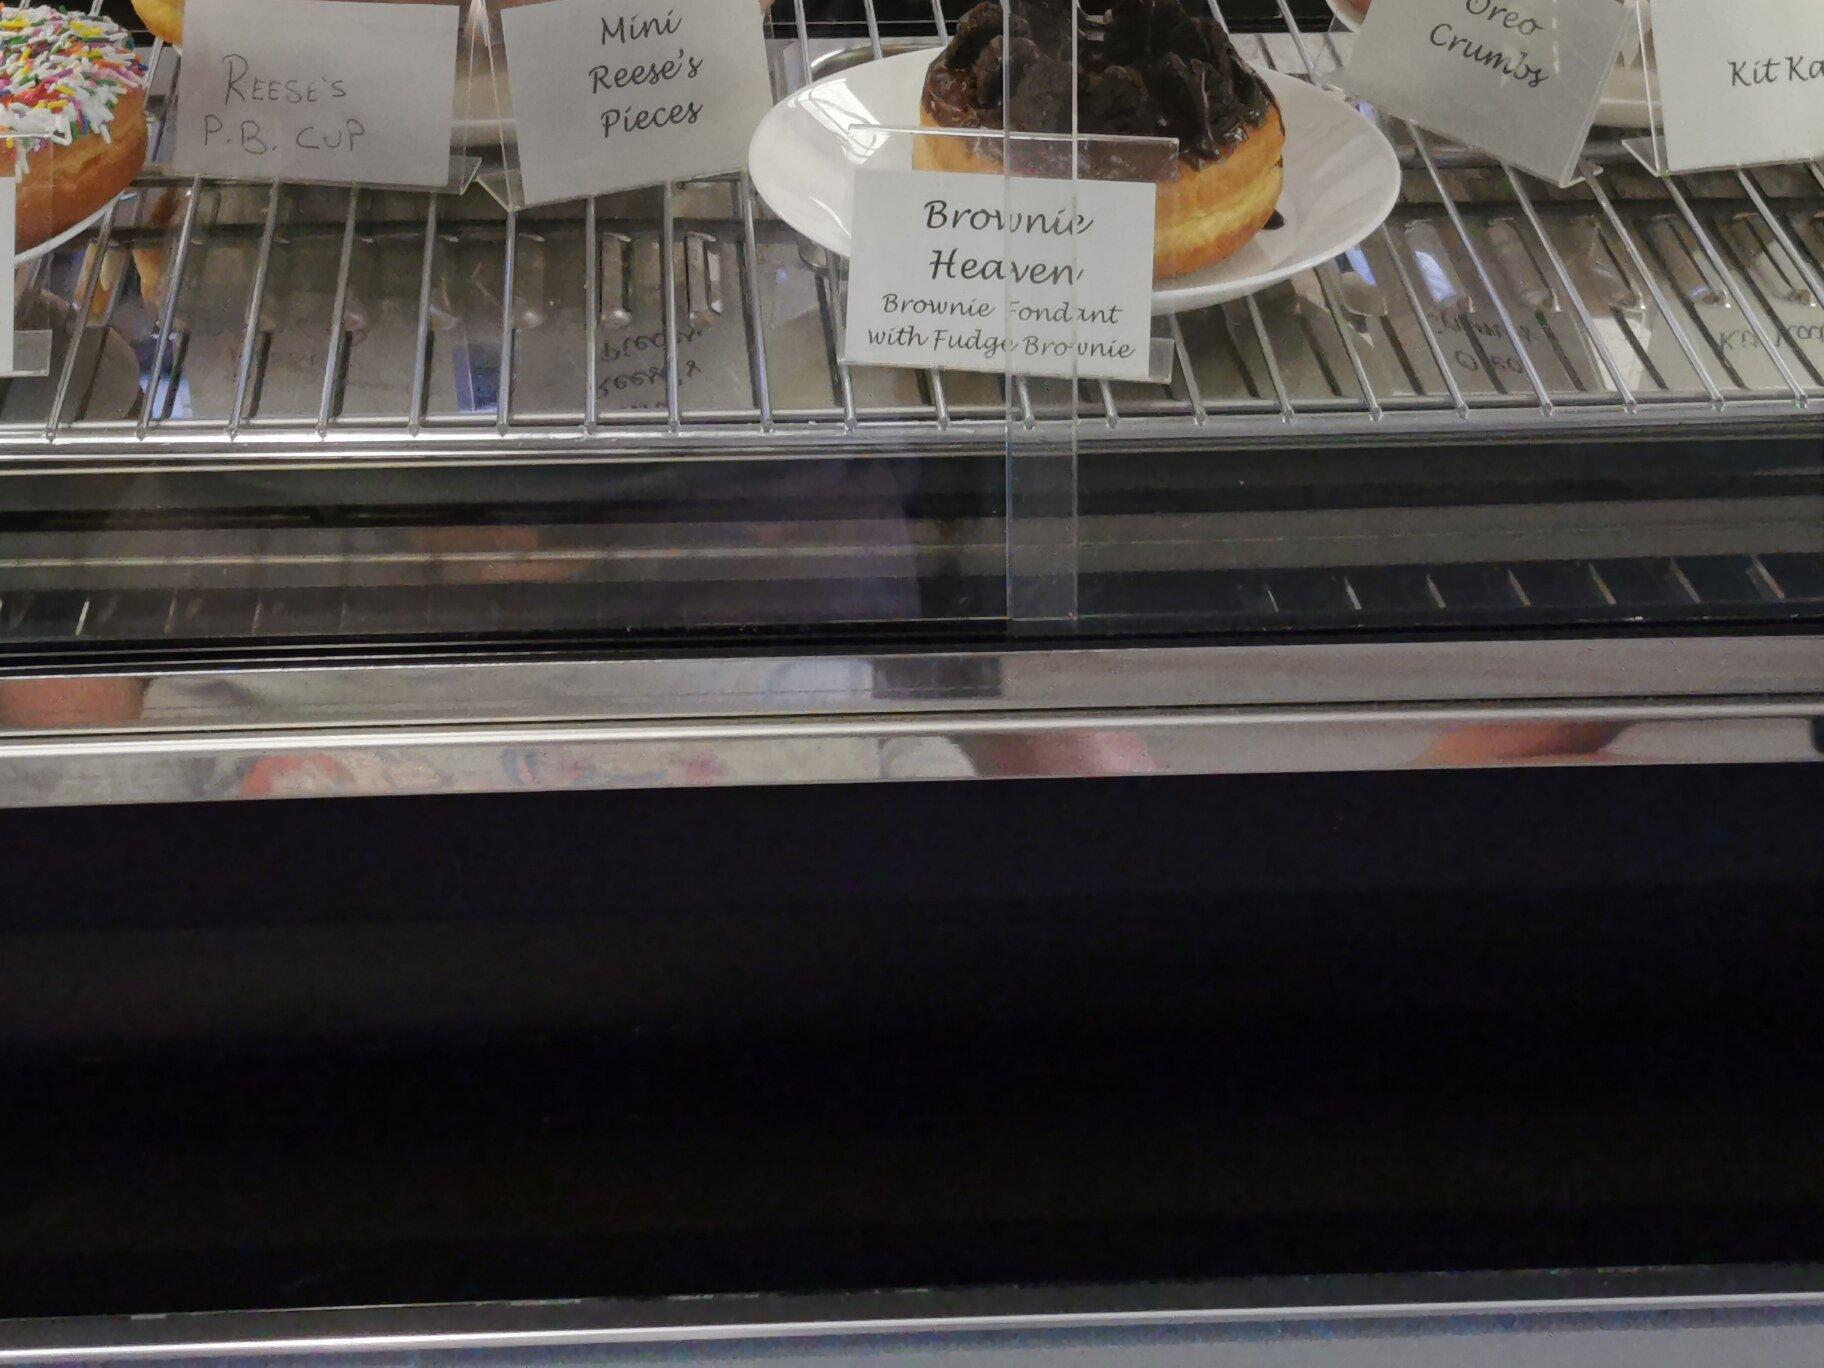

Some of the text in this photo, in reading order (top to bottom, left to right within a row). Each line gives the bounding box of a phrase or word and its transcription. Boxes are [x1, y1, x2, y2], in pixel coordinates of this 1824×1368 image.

[600, 10, 683, 44] Mini
[1429, 23, 1550, 89] Crumbs
[1729, 58, 1784, 88] Kit
[600, 98, 704, 138] Pieces
[923, 199, 1094, 235] Brownie
[928, 249, 1085, 285] Heaven
[882, 293, 997, 318] Brownie
[868, 325, 928, 347] with
